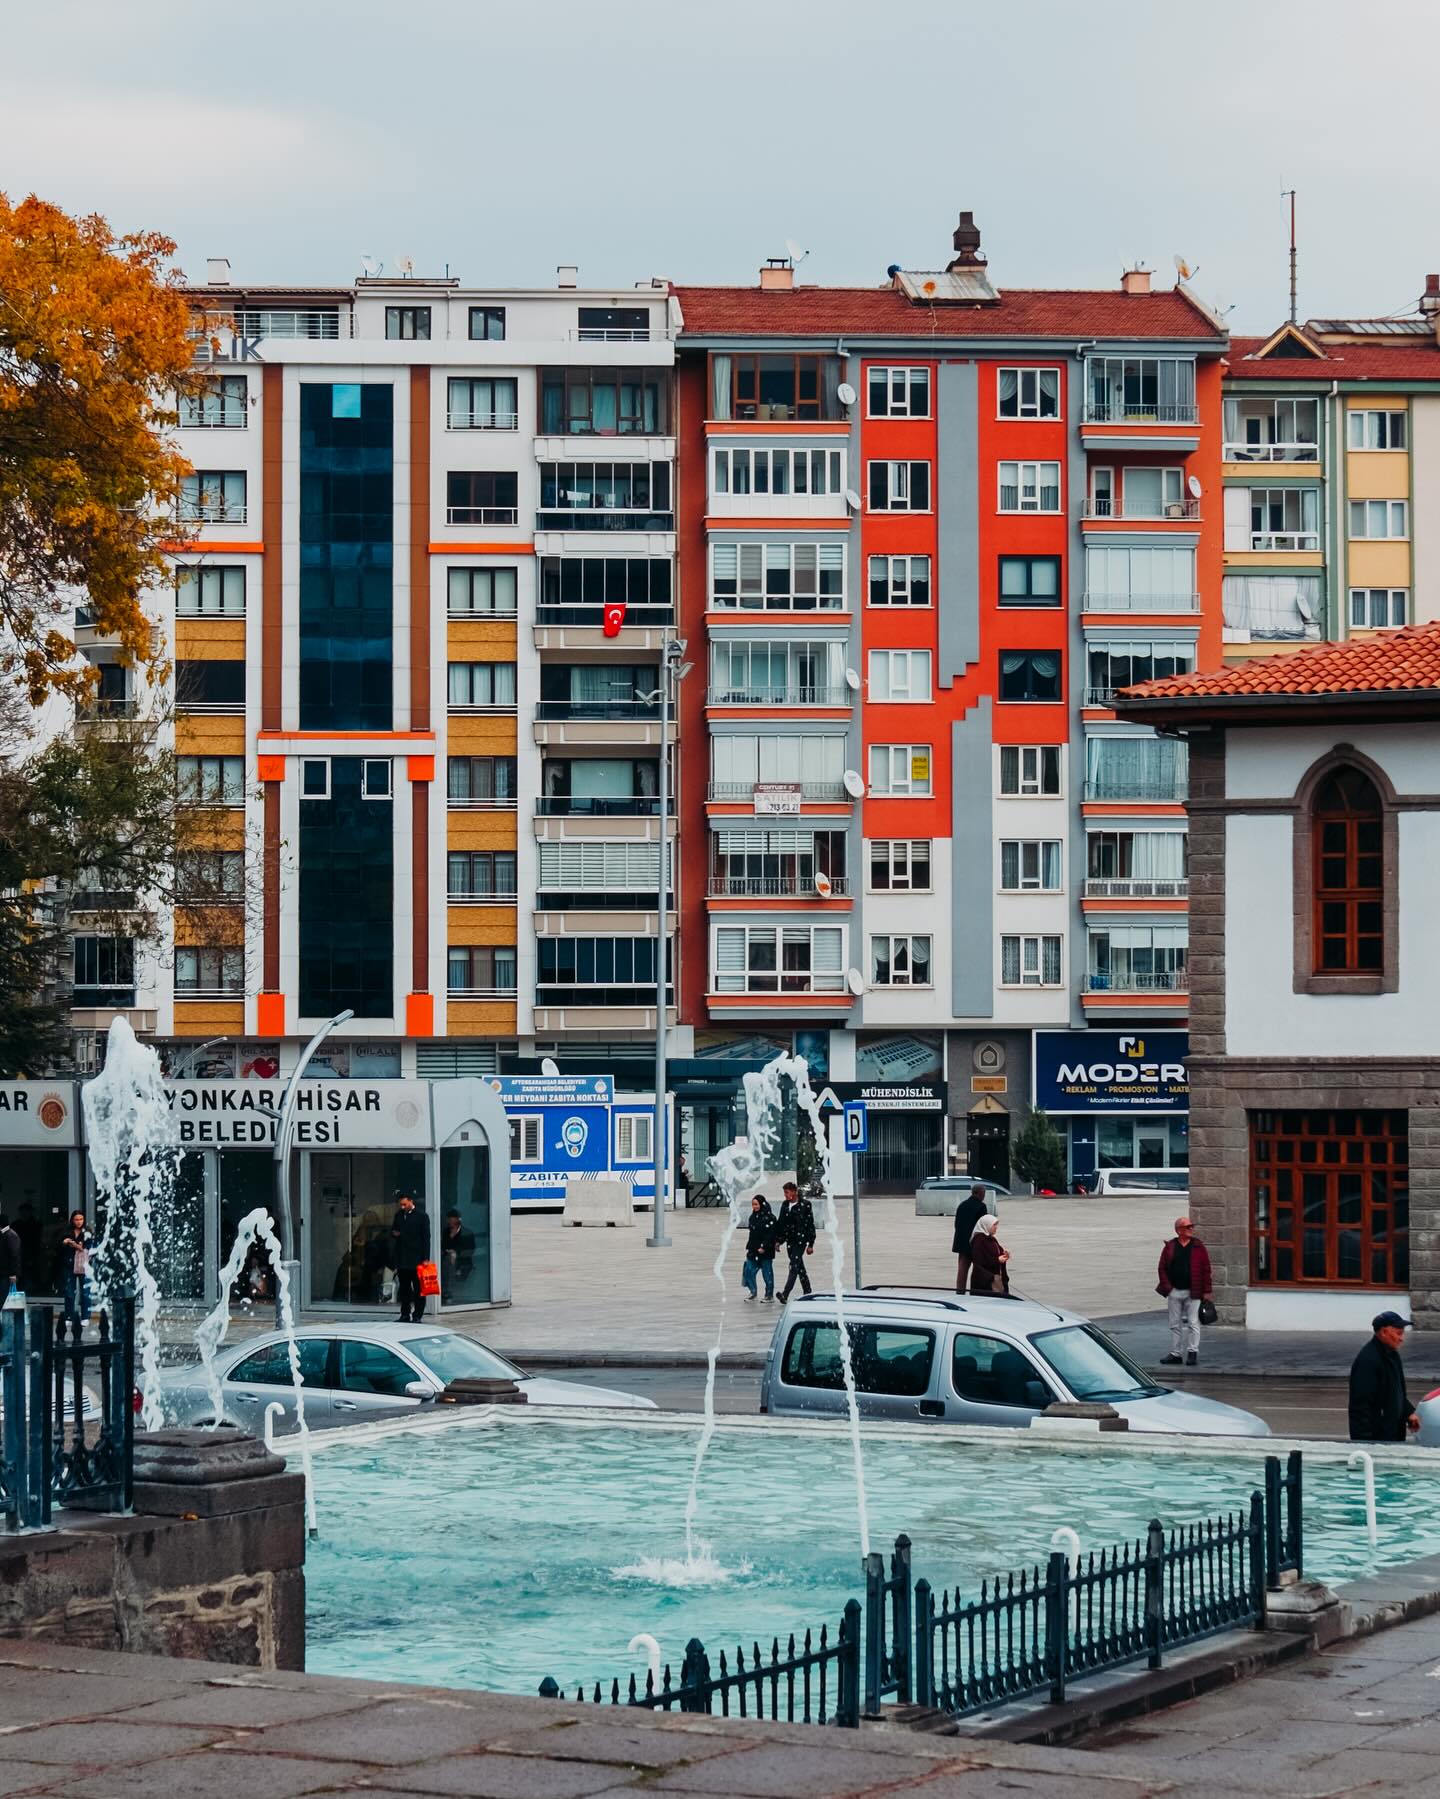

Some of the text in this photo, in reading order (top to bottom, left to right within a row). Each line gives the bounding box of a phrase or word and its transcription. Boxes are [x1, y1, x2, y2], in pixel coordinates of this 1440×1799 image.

[1056, 1064, 1189, 1083] MODER
[548, 1094, 575, 1102] ZABITA
[576, 1093, 609, 1102] NOKTASI
[860, 1086, 933, 1098] MÜHENDİSLİK
[180, 1115, 340, 1142] BELEDİESİ
[850, 1114, 860, 1140] D
[519, 1173, 569, 1181] ZABITA
